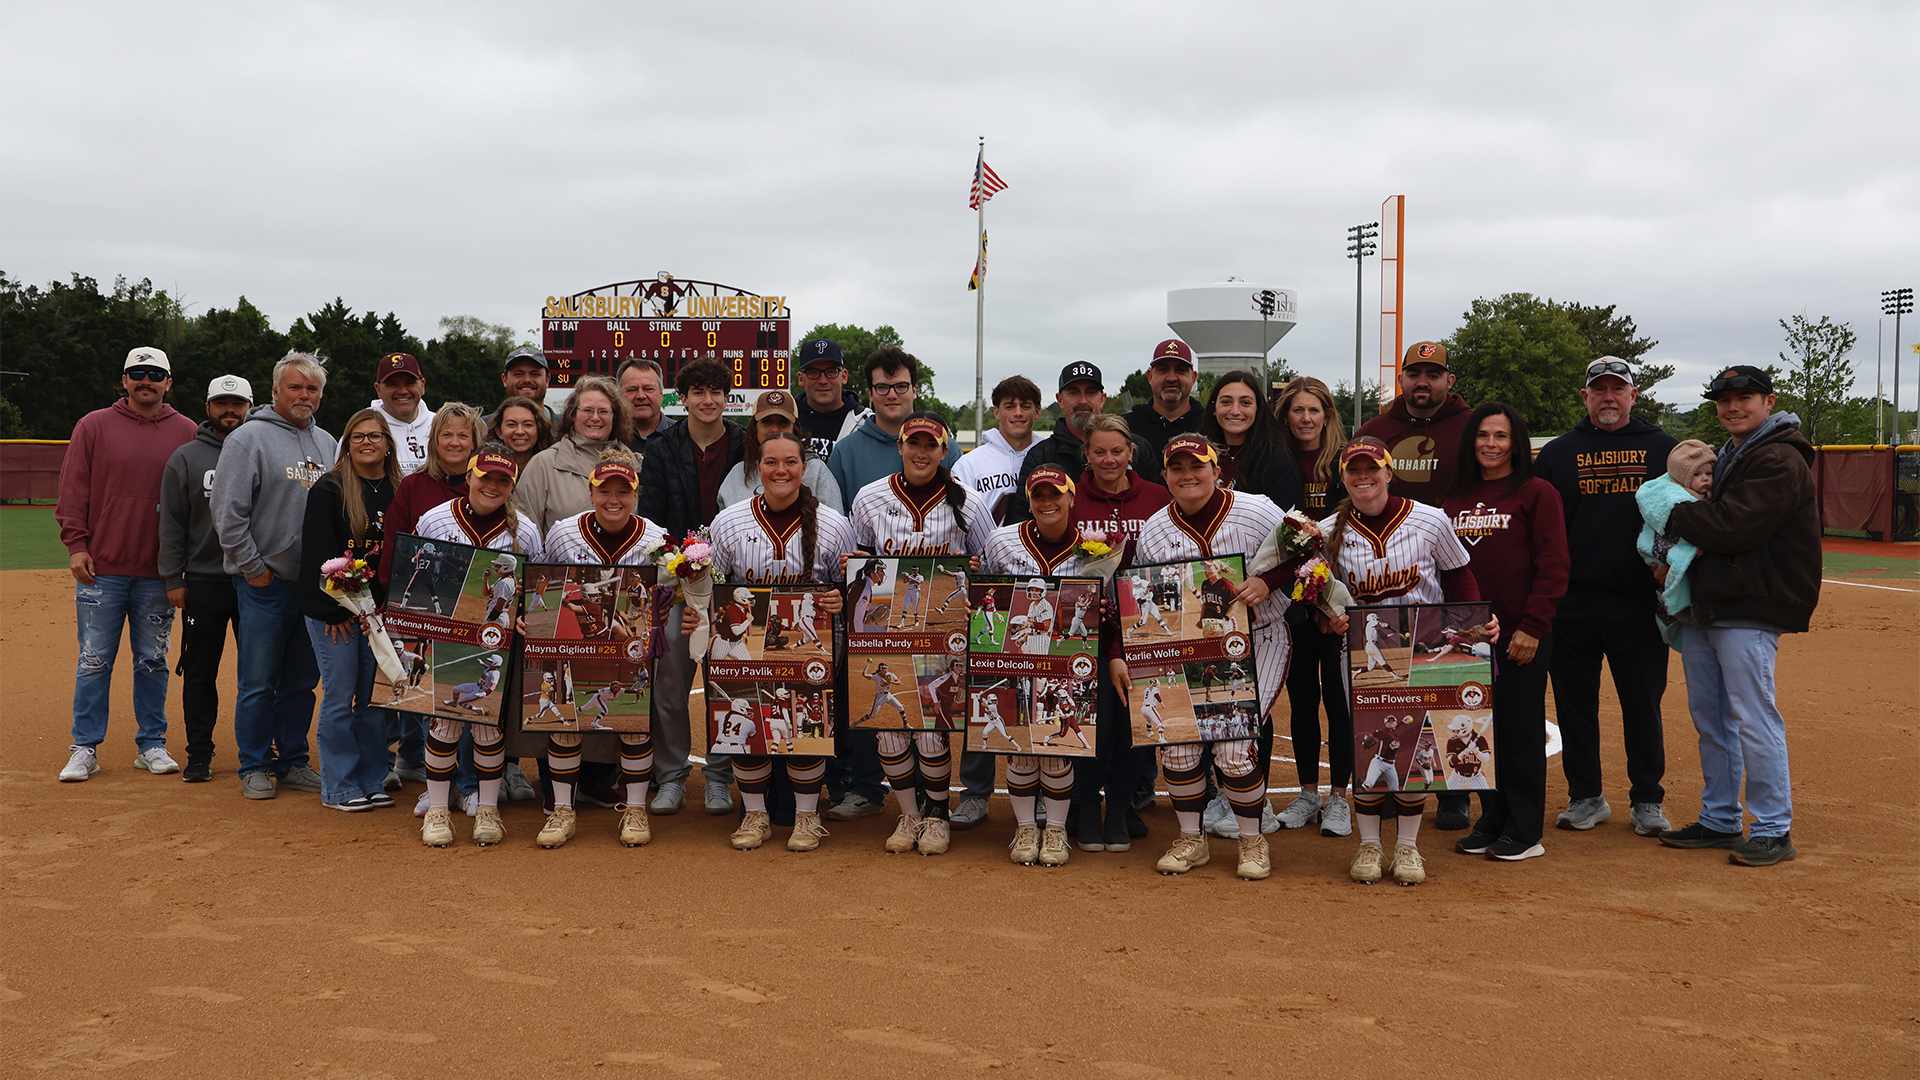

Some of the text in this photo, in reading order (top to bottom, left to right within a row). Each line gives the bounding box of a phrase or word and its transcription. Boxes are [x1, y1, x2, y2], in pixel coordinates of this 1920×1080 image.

[546, 296, 786, 317] SALISBURY UNIVERSITY
[548, 322, 579, 331] AT BAT
[606, 322, 630, 331] BALL
[649, 322, 682, 331] STRIKE
[702, 322, 721, 331] OUT
[760, 322, 776, 332] H/E
[614, 332, 624, 348] 0
[660, 332, 670, 348] 0
[707, 332, 716, 348] 0
[590, 350, 788, 358] 1 2 3 4 5 6 7 8 9 10 RUNS HITS ERR
[391, 355, 404, 369] S
[558, 359, 571, 368] YC
[734, 358, 785, 372] 0 0 0
[1072, 366, 1094, 376] 302
[558, 374, 570, 384] SU
[734, 374, 785, 386] 0 0 0
[1393, 458, 1439, 470] ARHARTT
[1576, 450, 1648, 467] SALISBURY
[976, 473, 1018, 494] ARIZON
[1450, 514, 1512, 530] ALISBURY
[1456, 528, 1493, 537] SOFTBALL
[418, 558, 430, 570] 27
[1348, 562, 1421, 597] Salisbury
[385, 617, 422, 629] McKenna
[424, 622, 452, 634] Horner
[452, 628, 469, 636] #27
[524, 644, 616, 655] Alayna Gigliotti #26
[848, 639, 930, 649] Isabella Purdy #15
[1125, 646, 1194, 662] Karlie Wolfe #9
[970, 658, 1052, 670] Lexie Delcollo #11
[710, 666, 795, 678] Merry Pavlik #24
[1356, 693, 1438, 704] Sam Flowers #8
